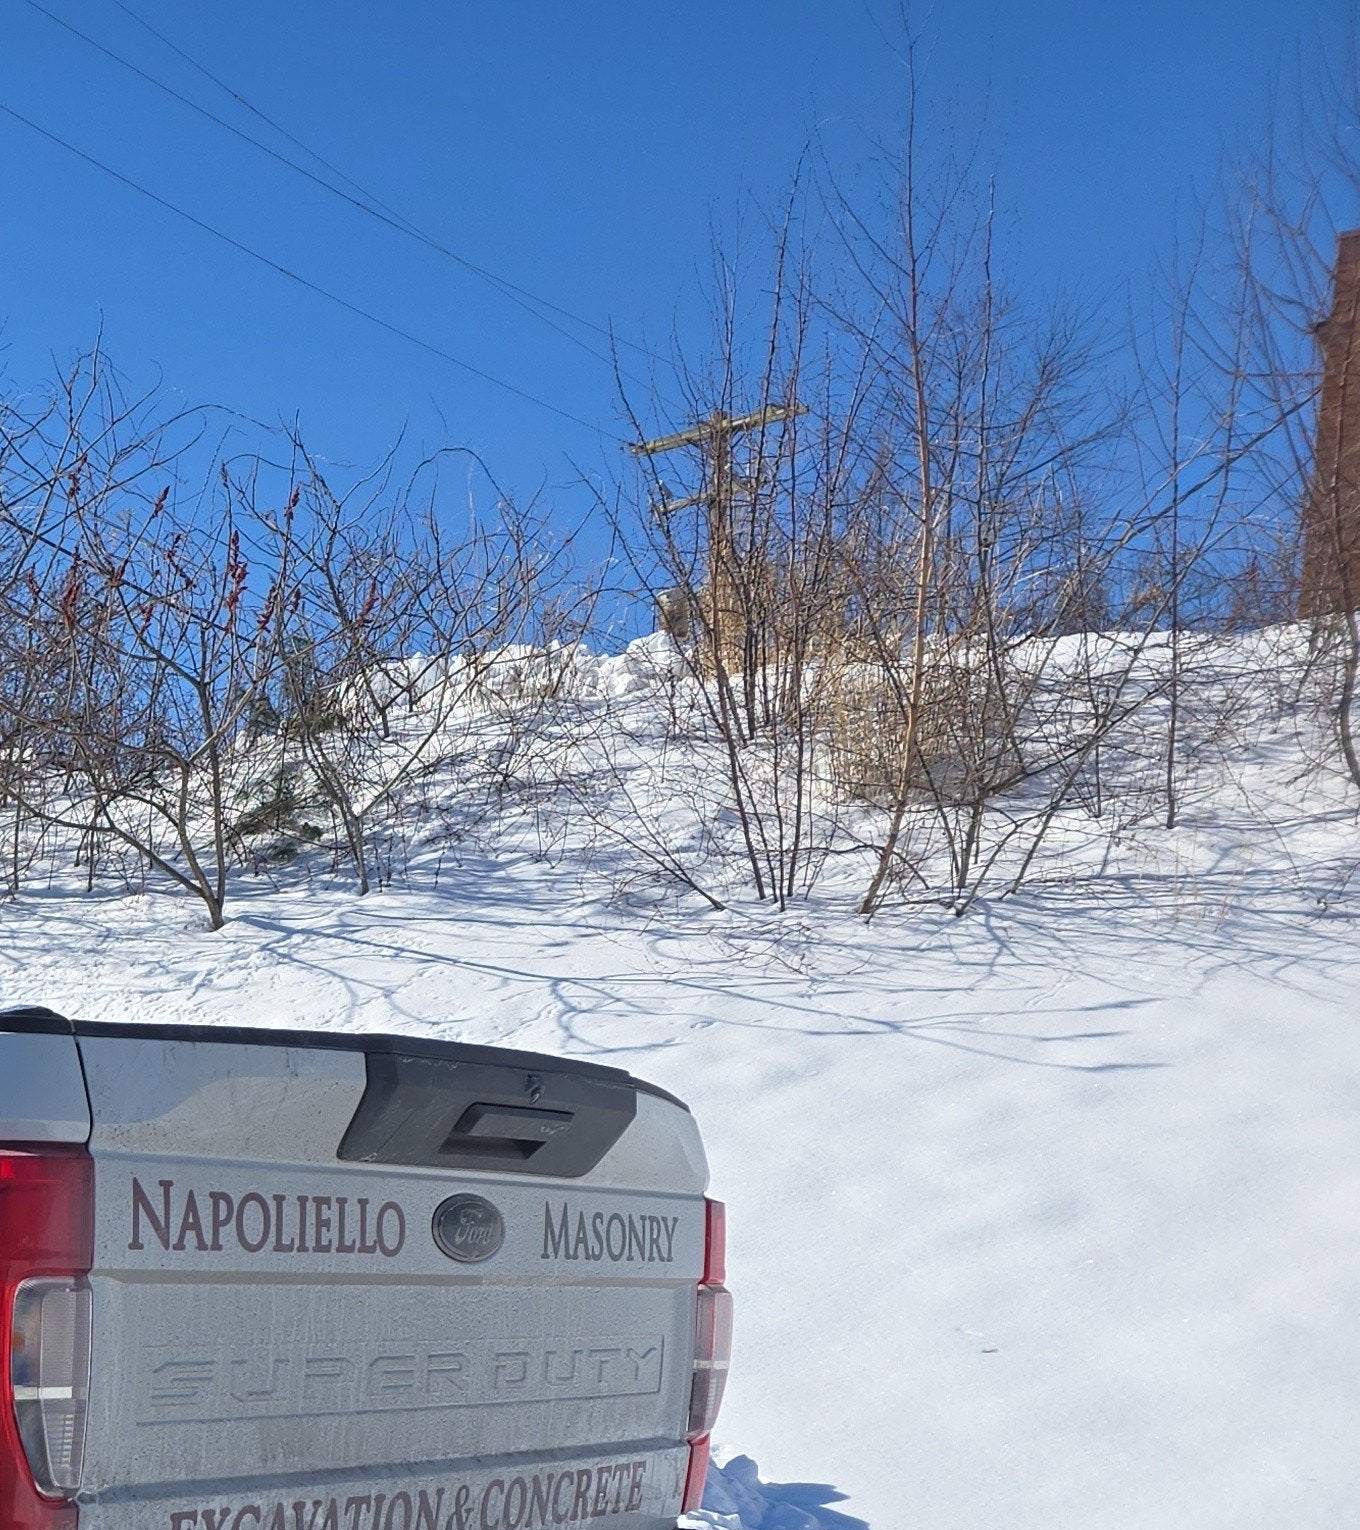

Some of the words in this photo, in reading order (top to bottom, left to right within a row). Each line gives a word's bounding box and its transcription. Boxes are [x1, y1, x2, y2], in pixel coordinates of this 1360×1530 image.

[127, 1176, 407, 1258] NAPOLIELLO
[540, 1201, 680, 1264] MASONRY
[150, 1351, 470, 1407] SUPER
[493, 1346, 659, 1391] DUTY
